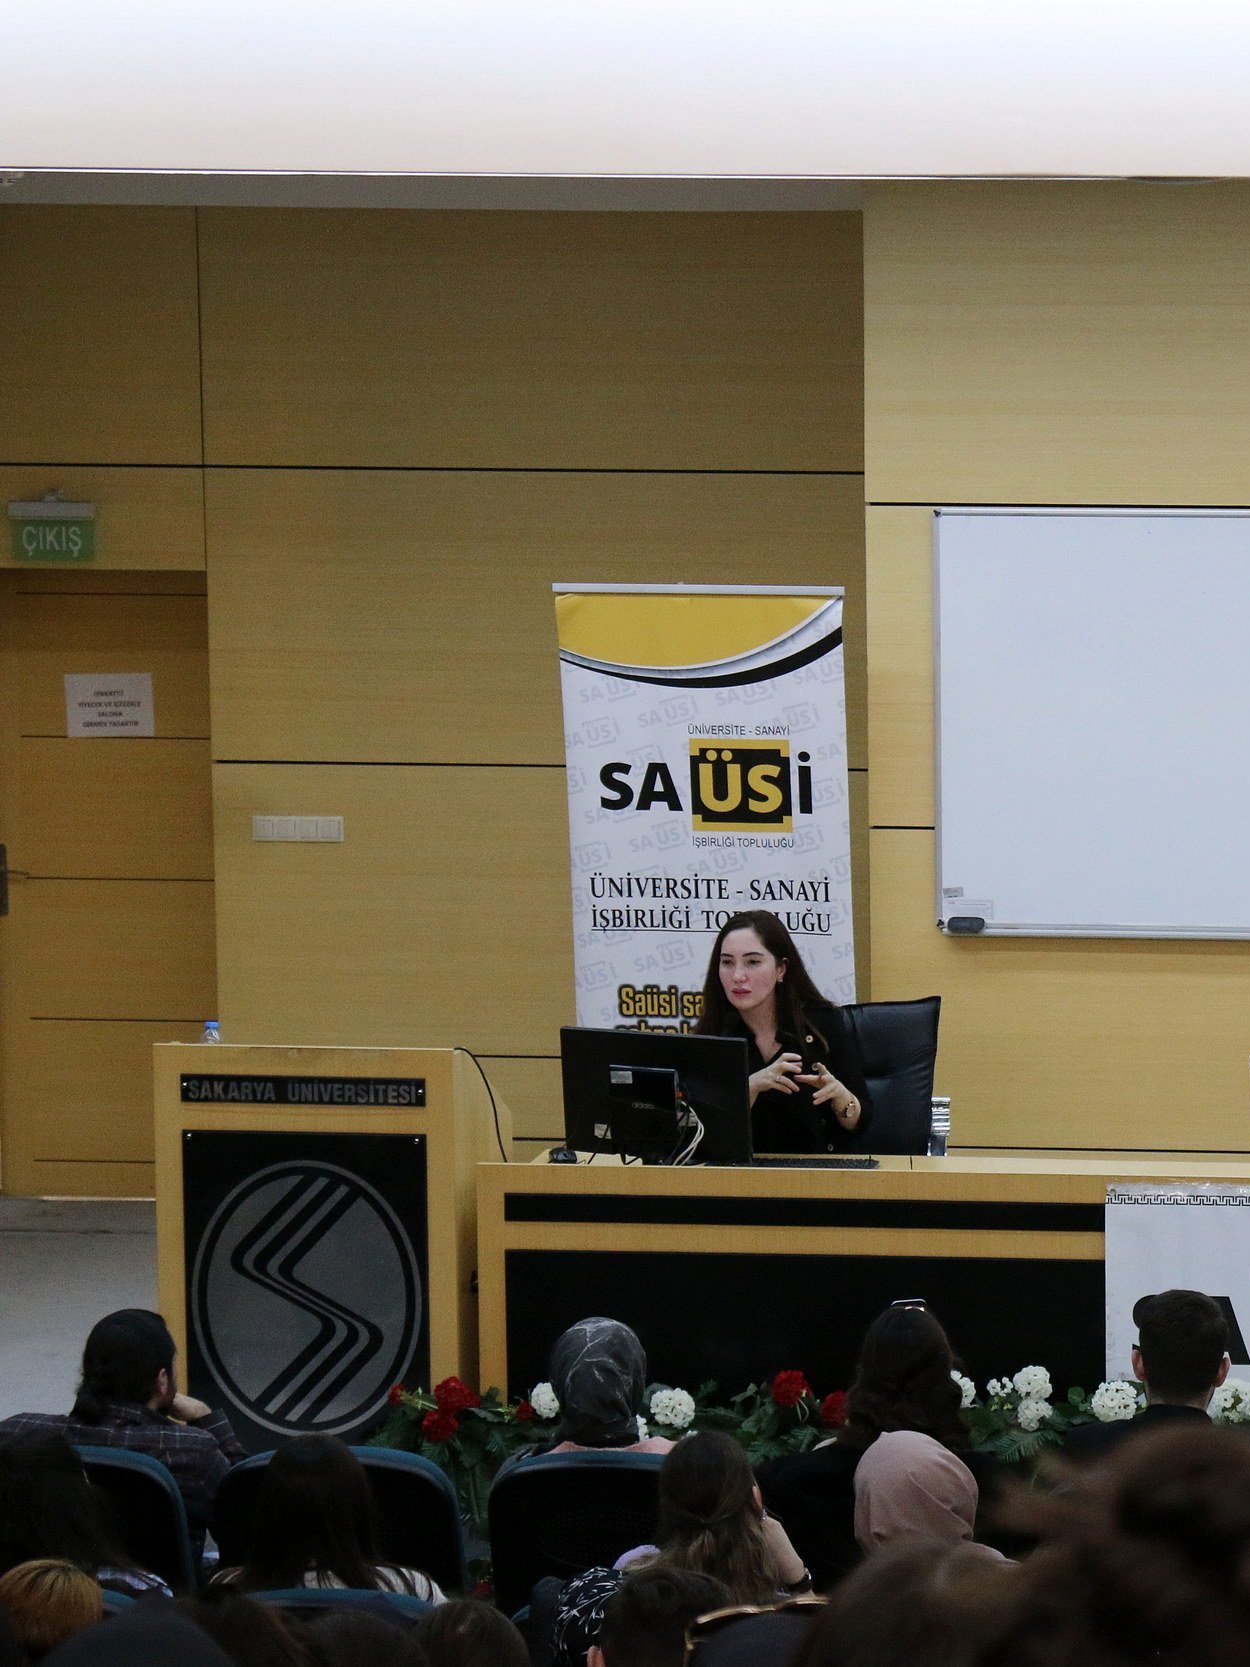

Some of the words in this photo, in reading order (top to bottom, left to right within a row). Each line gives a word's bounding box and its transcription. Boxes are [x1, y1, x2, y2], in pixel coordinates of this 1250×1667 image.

[22, 525, 82, 558] ÇIKIŞ
[687, 723, 746, 736] ÜNİVERSİTE
[754, 724, 790, 736] SANAYİ
[692, 835, 735, 849] İŞBİRLİĞİ
[736, 836, 795, 849] TOPLULUĞU
[589, 872, 730, 900] ÜNİVERSİTE
[750, 876, 831, 903] SANAYİ
[591, 904, 693, 933] İŞBİRLİĞİ
[701, 907, 831, 933] TOUĞU
[619, 985, 679, 1017] Saüsi
[187, 1079, 277, 1102] SAKARYA
[287, 1080, 417, 1104] ÜNİVERSİTESİ
